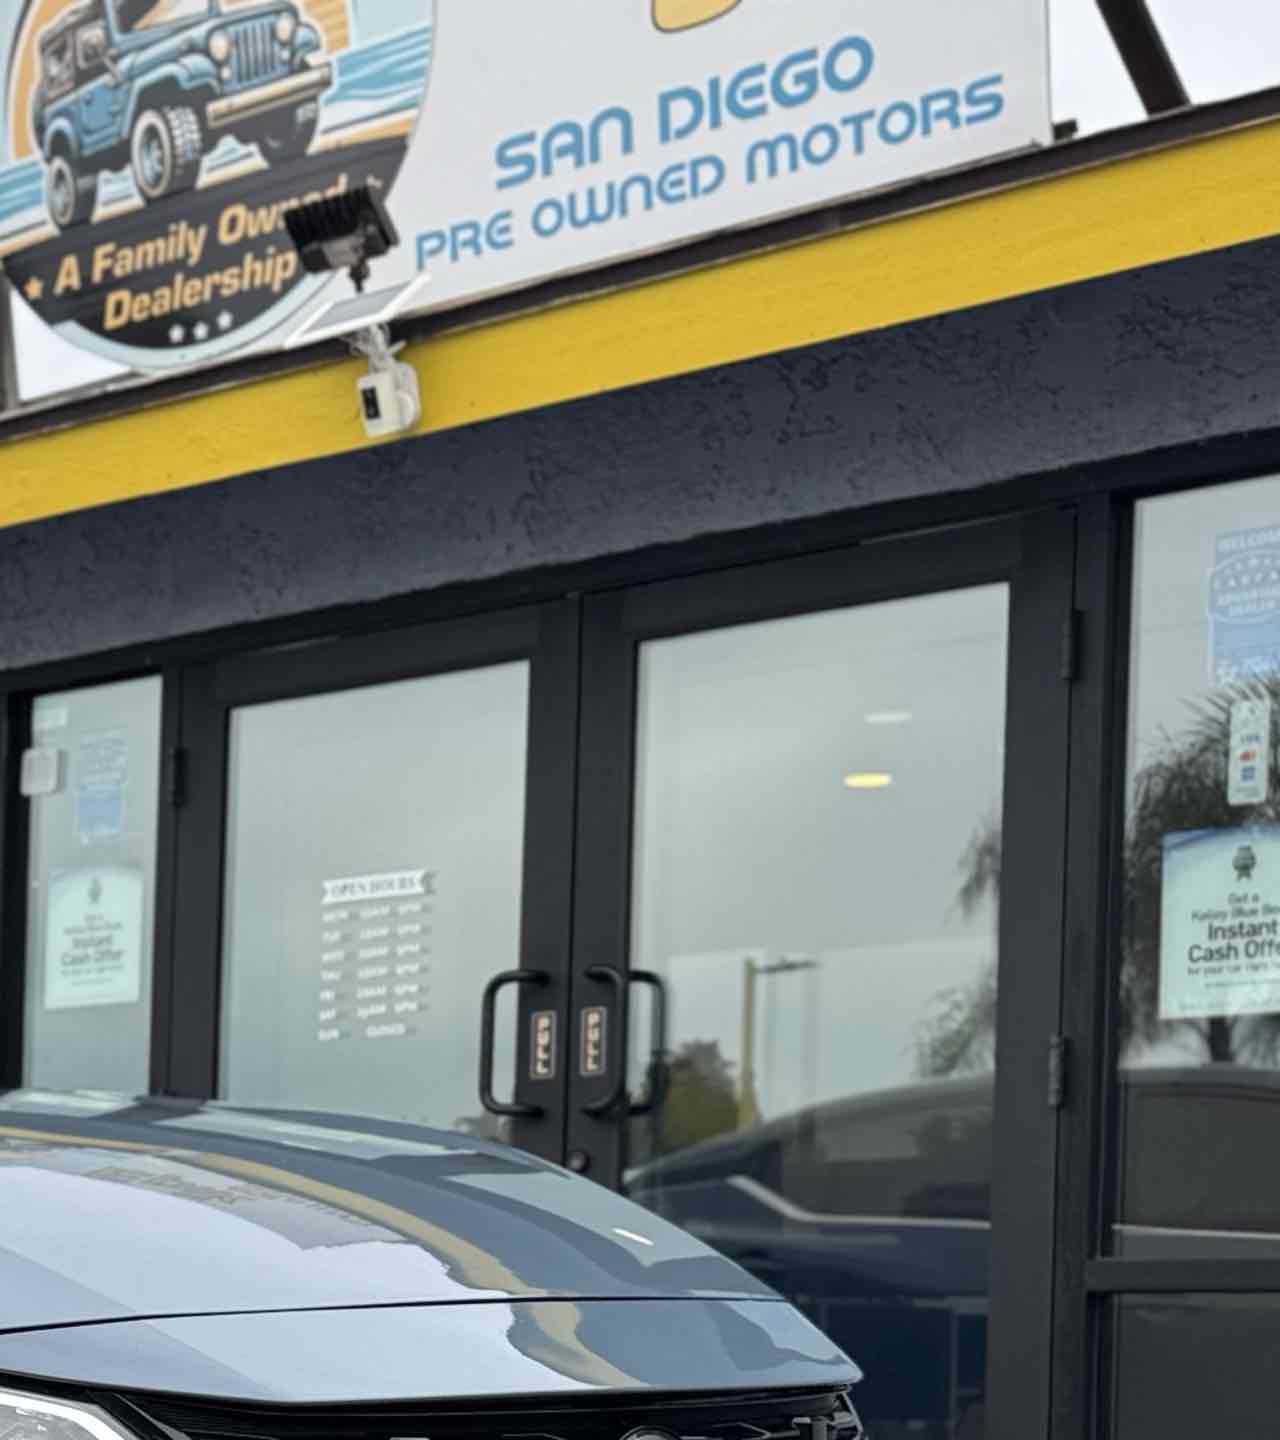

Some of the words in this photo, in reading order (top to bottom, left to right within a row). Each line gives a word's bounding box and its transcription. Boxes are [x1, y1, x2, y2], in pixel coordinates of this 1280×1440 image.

[494, 104, 634, 189] SAN
[657, 35, 876, 143] DIEGO
[414, 210, 515, 271] PRE
[530, 153, 726, 238] OWNED
[745, 74, 1006, 184] MOTORS
[54, 252, 81, 293] A
[92, 219, 209, 284] Family
[103, 245, 298, 330] Dealership
[1187, 942, 1239, 963] Cash
[1207, 920, 1278, 941] Instant
[537, 1016, 549, 1073] PULL
[587, 1012, 600, 1071] PULL
